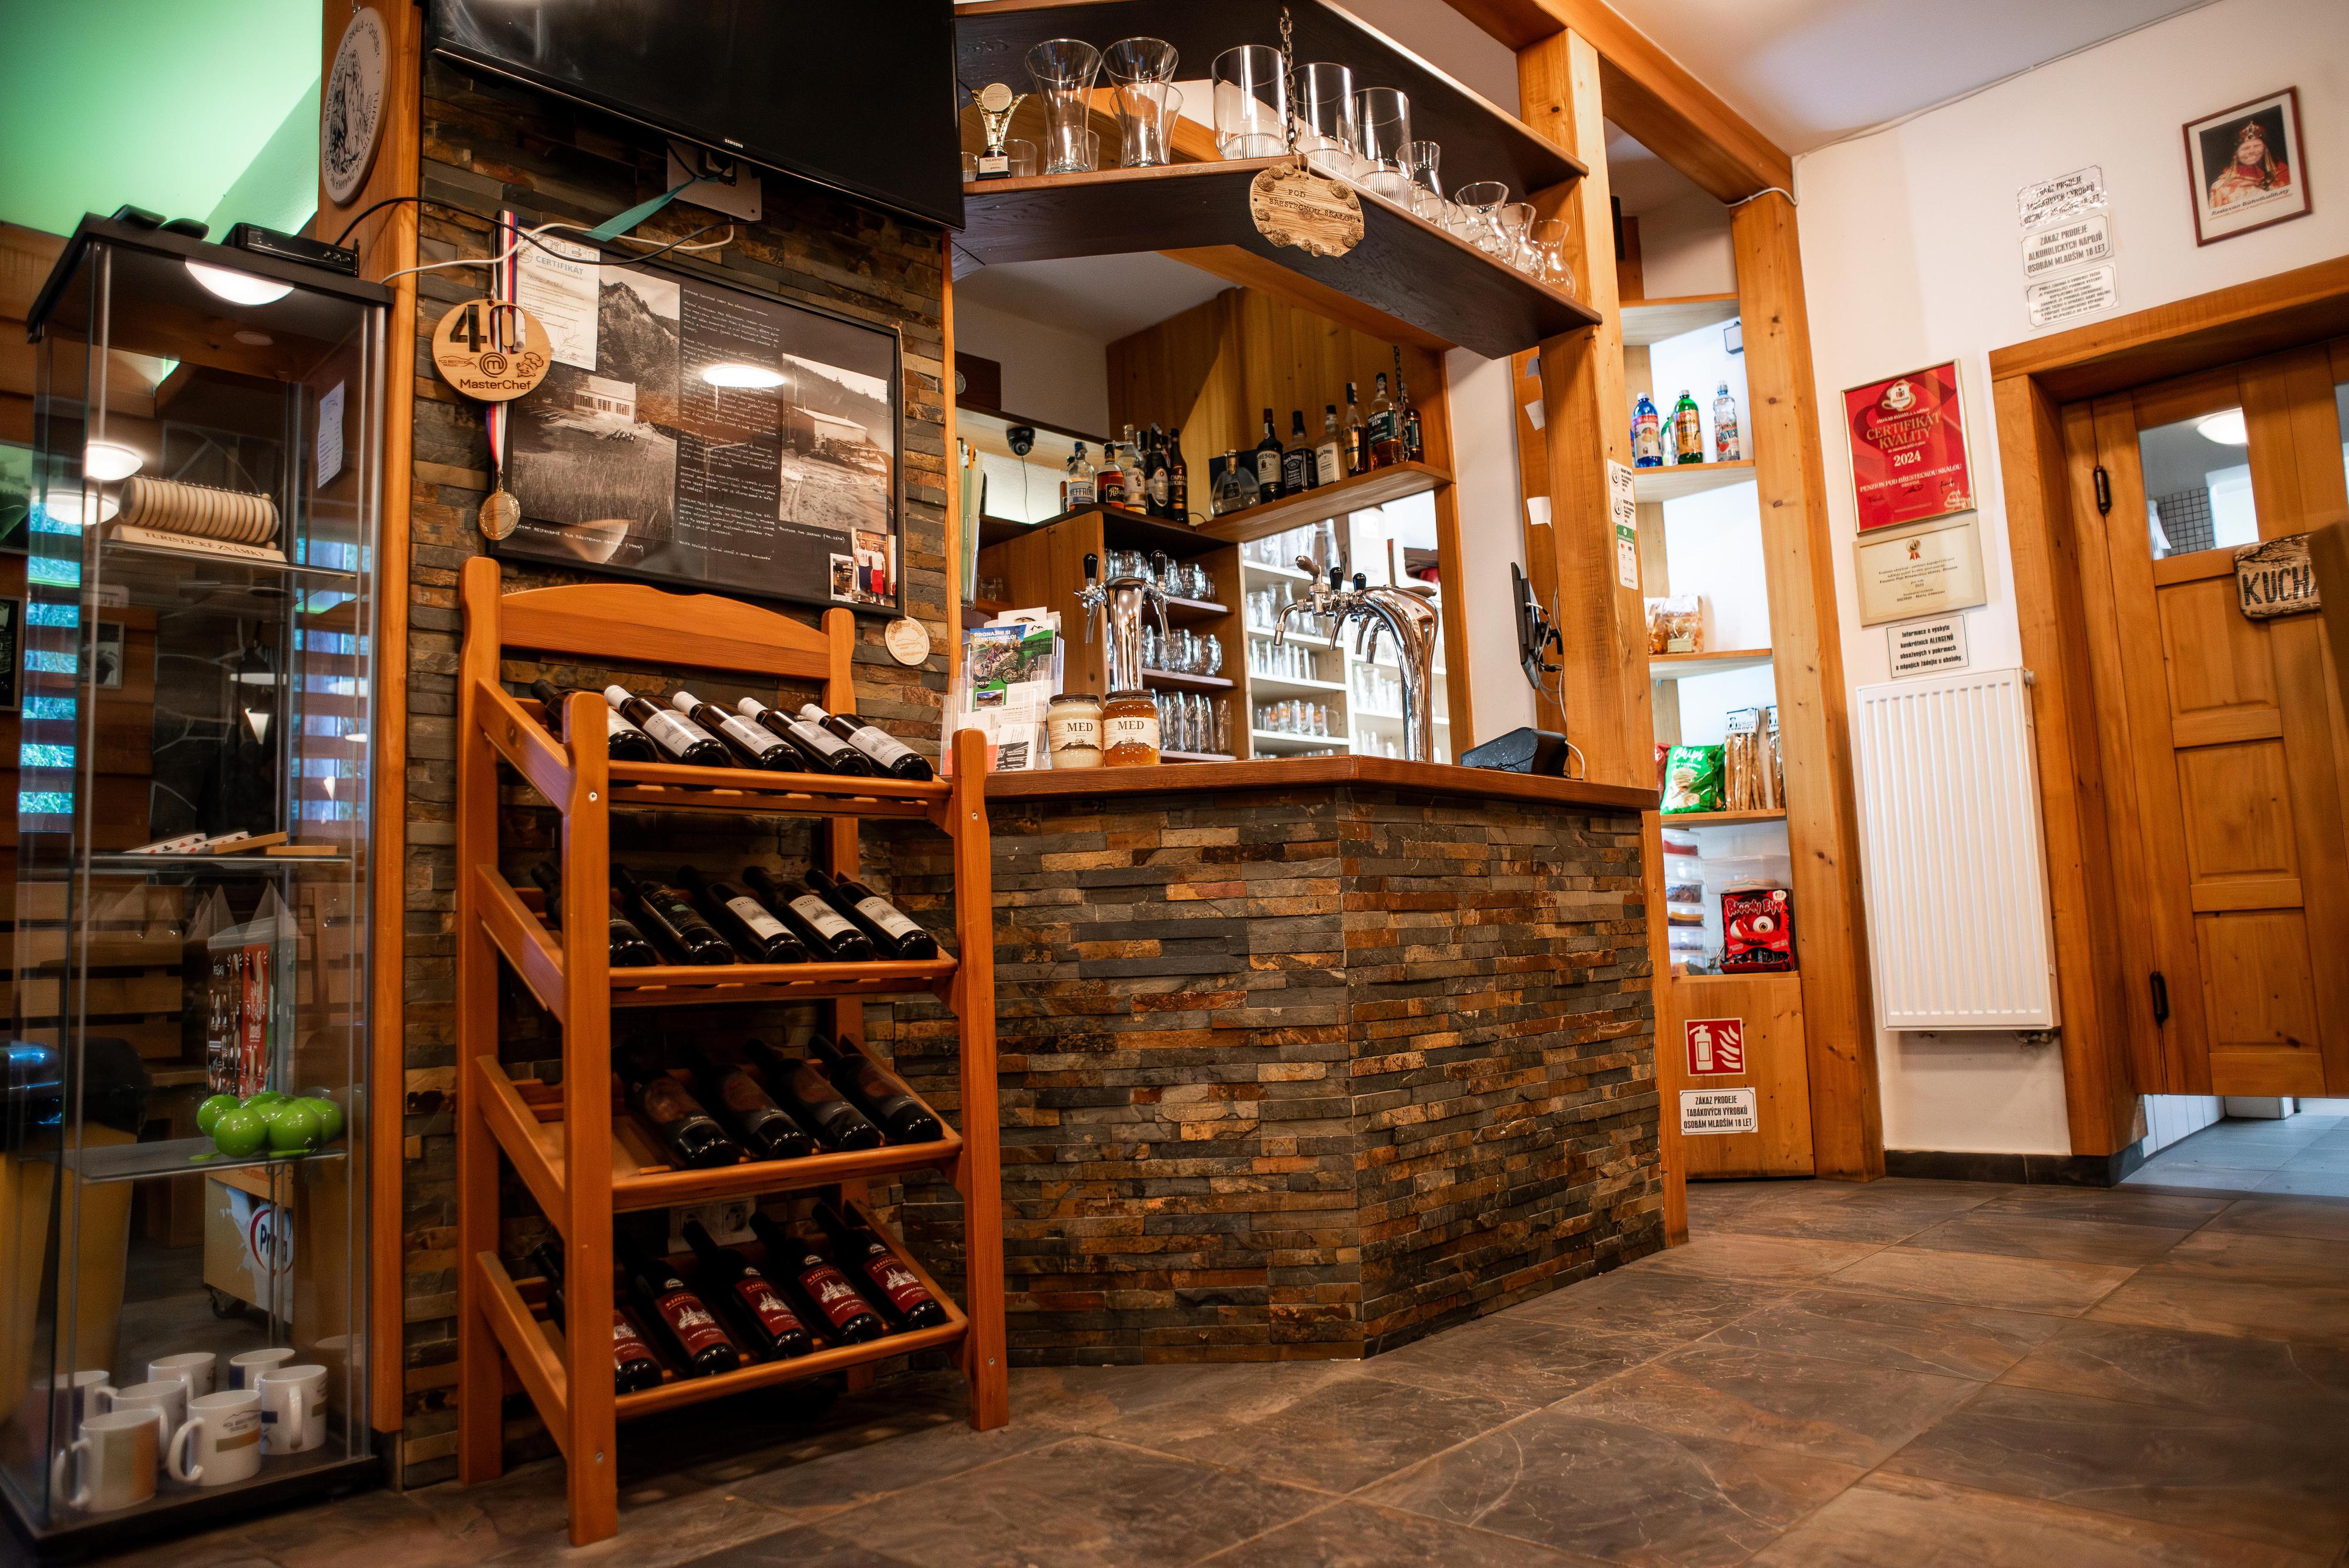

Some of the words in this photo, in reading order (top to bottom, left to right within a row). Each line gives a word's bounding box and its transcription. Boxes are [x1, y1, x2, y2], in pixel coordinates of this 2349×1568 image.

[725, 139, 743, 149] SAMSUNG
[1288, 189, 1306, 198] POD
[1324, 210, 1356, 223] SKALOU
[2040, 233, 2059, 246] ZÁKAZ
[2061, 224, 2088, 240] PRODEJE
[2028, 239, 2077, 261] ALKOHOLICKÝCH
[2079, 230, 2103, 247] NÁPOJŮ
[2027, 258, 2054, 273] OSOBÁM
[2055, 249, 2084, 265] MLADŠÍM
[2085, 247, 2094, 257] 18
[2095, 243, 2105, 254] LET
[536, 255, 584, 276] CERTIFIKÁT
[450, 304, 527, 354] 40
[460, 379, 531, 390] MasterChef
[1866, 412, 1940, 441] CERTIFIKÁT
[1879, 427, 1931, 450] KVALITY
[1893, 450, 1921, 467] 2024
[218, 544, 265, 557] ZNÁMKY
[2242, 564, 2318, 606] KUCH
[1902, 629, 1926, 638] Informace
[1931, 624, 1950, 633] výskytu
[974, 634, 1017, 643] ELEKTROKOLO!
[1900, 639, 1929, 649] konkrétních
[1930, 632, 1954, 644] ALERGENŮ
[1900, 650, 1927, 659] obsažených
[1932, 645, 1957, 655] pokrmech
[1900, 661, 1920, 670] nápojích
[1921, 659, 1937, 667] žádejte
[1067, 722, 1093, 732] MED
[1118, 721, 1145, 731] MED
[1674, 747, 1704, 762] Chips
[1725, 898, 1762, 917] Bloody
[1762, 899, 1783, 915] Eye
[1695, 1095, 1713, 1105] ZÁKAZ
[1714, 1095, 1738, 1104] PRODEJE
[1687, 1106, 1722, 1117] TABÁKOVÝCH
[1722, 1105, 1748, 1115] VÝROBKŮ
[1684, 1119, 1707, 1129] OSOBÁM
[1708, 1118, 1734, 1128] MLADŠÍM
[1735, 1119, 1742, 1127] 18
[1743, 1118, 1752, 1127] LET
